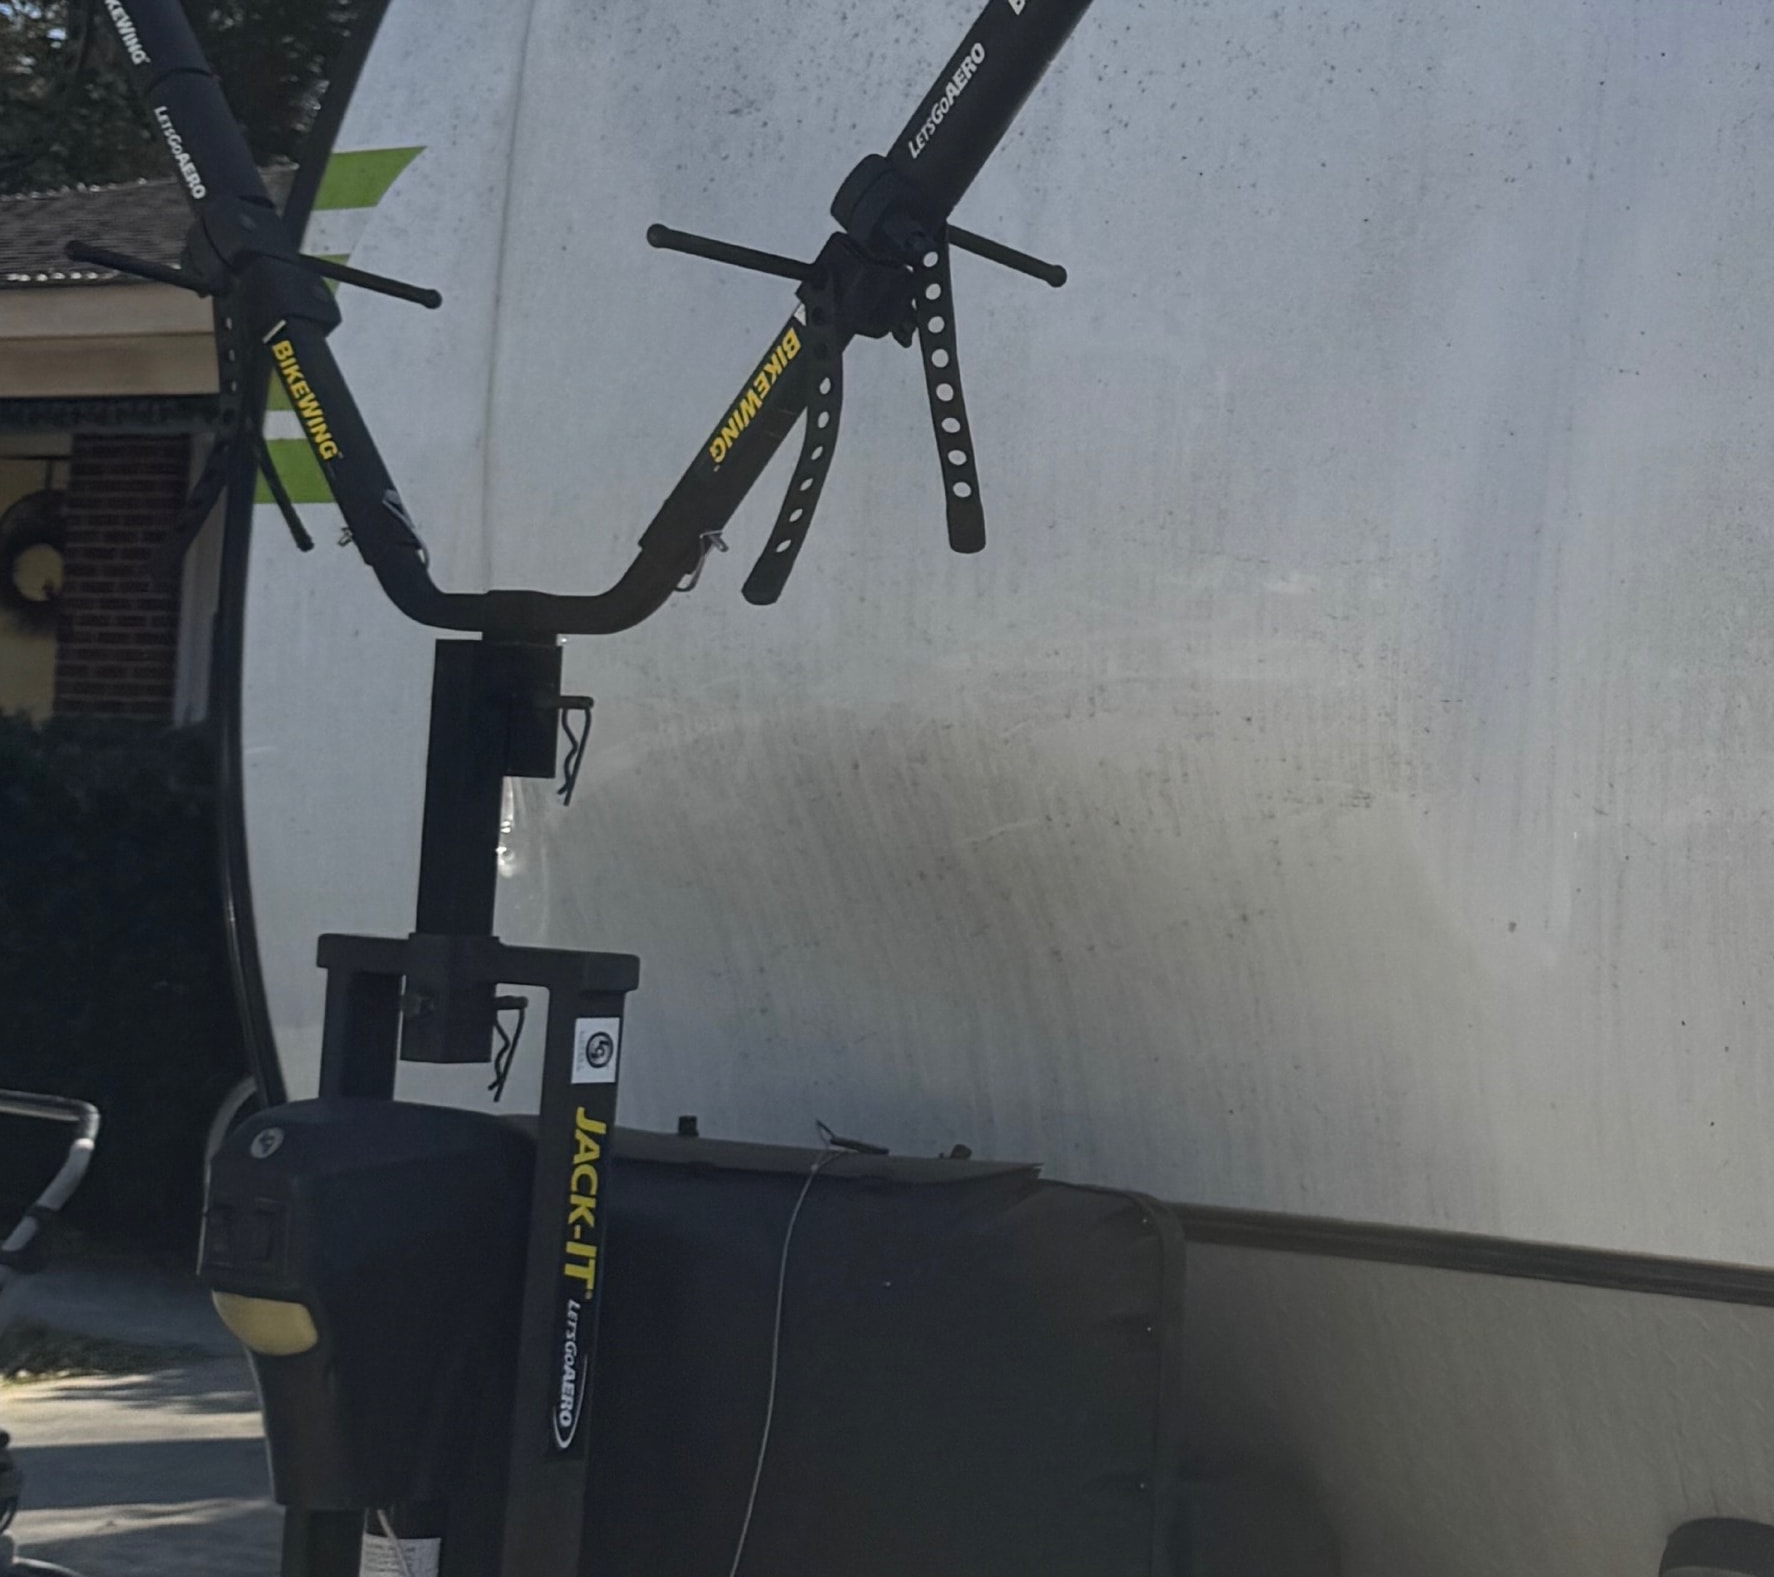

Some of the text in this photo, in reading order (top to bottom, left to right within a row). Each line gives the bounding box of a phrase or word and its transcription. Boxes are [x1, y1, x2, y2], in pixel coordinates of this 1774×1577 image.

[272, 339, 338, 460] BIKEWING
[709, 327, 801, 464] BIKEWING
[564, 1107, 606, 1299] JACK-IT
